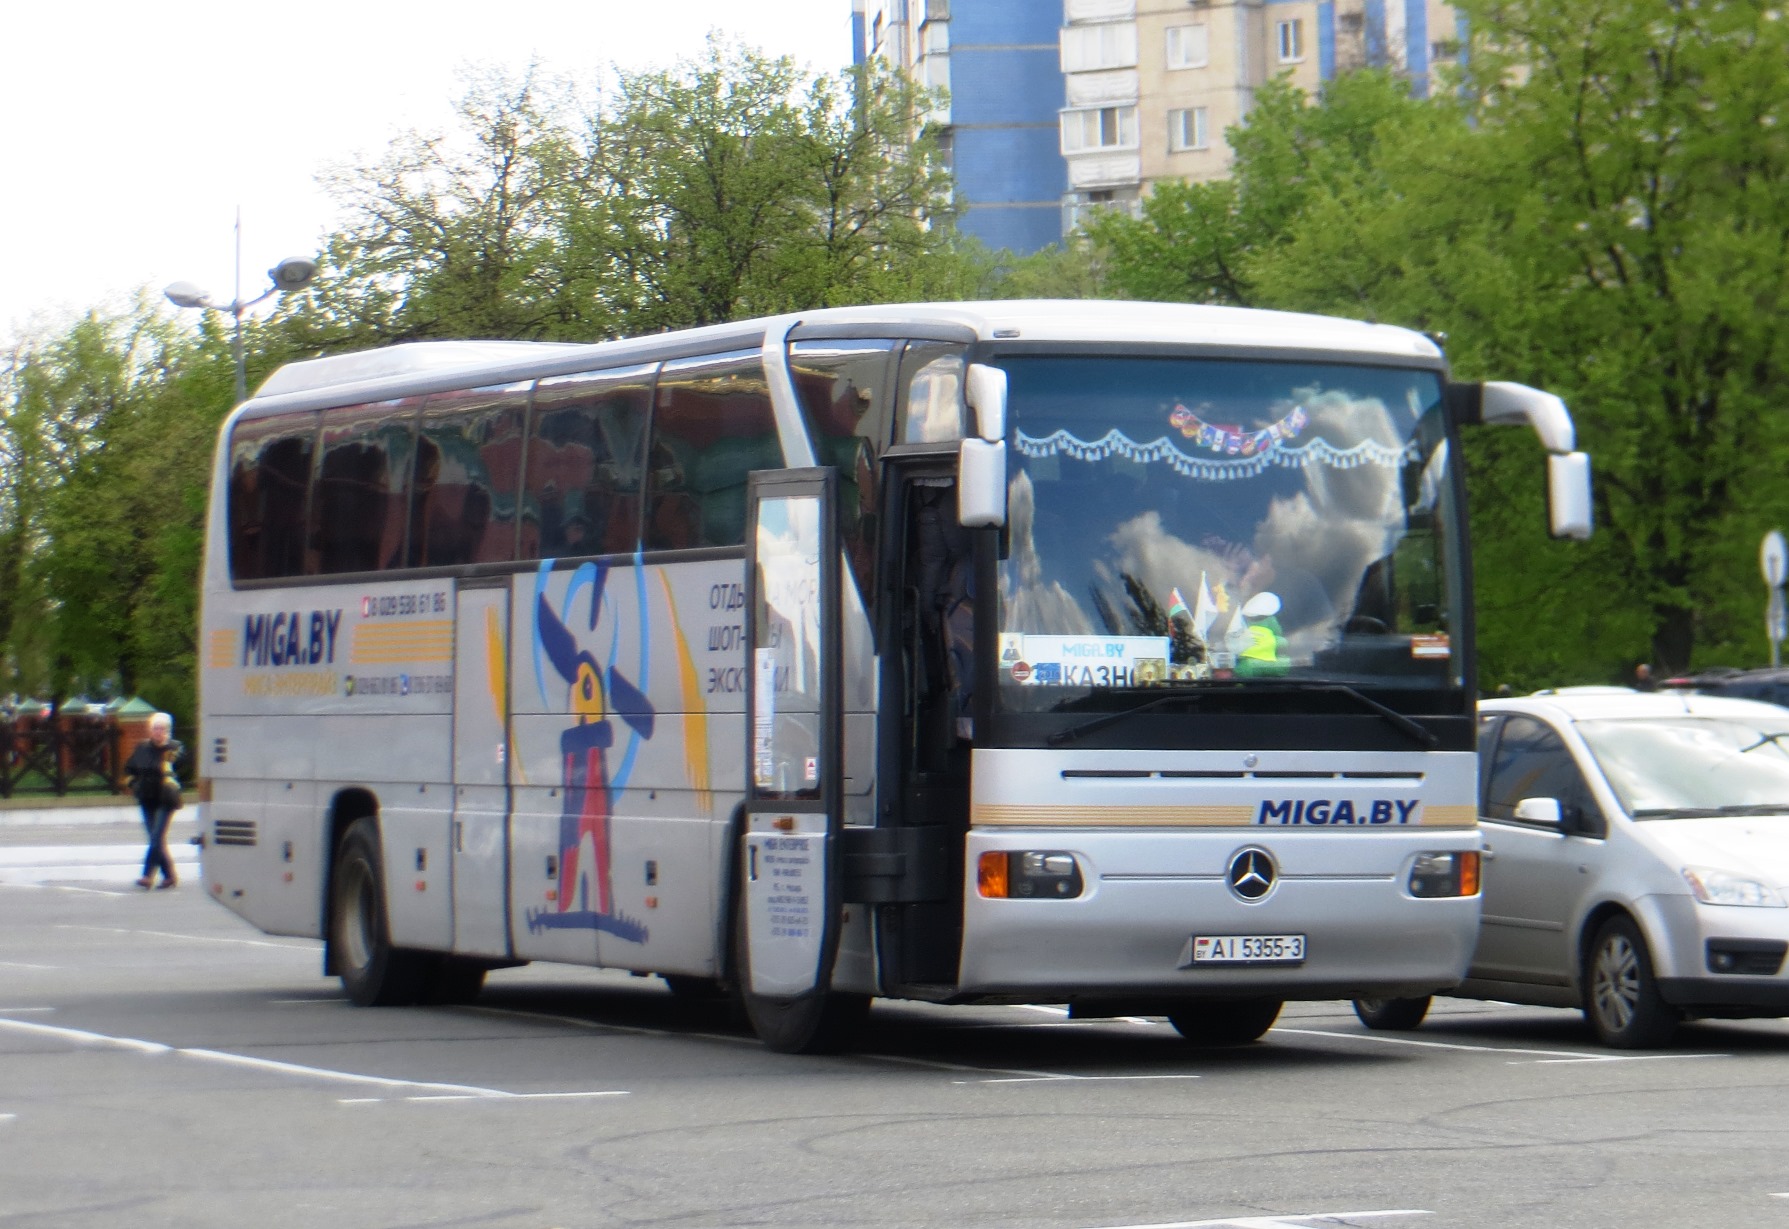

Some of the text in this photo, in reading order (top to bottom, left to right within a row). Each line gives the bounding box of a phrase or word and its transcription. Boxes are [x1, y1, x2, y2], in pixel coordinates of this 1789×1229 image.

[242, 609, 343, 667] MIGA.BY
[1062, 643, 1125, 658] MIGA.BY
[1258, 799, 1421, 826] MIGA.BY
[1243, 938, 1301, 958] 5355-3
